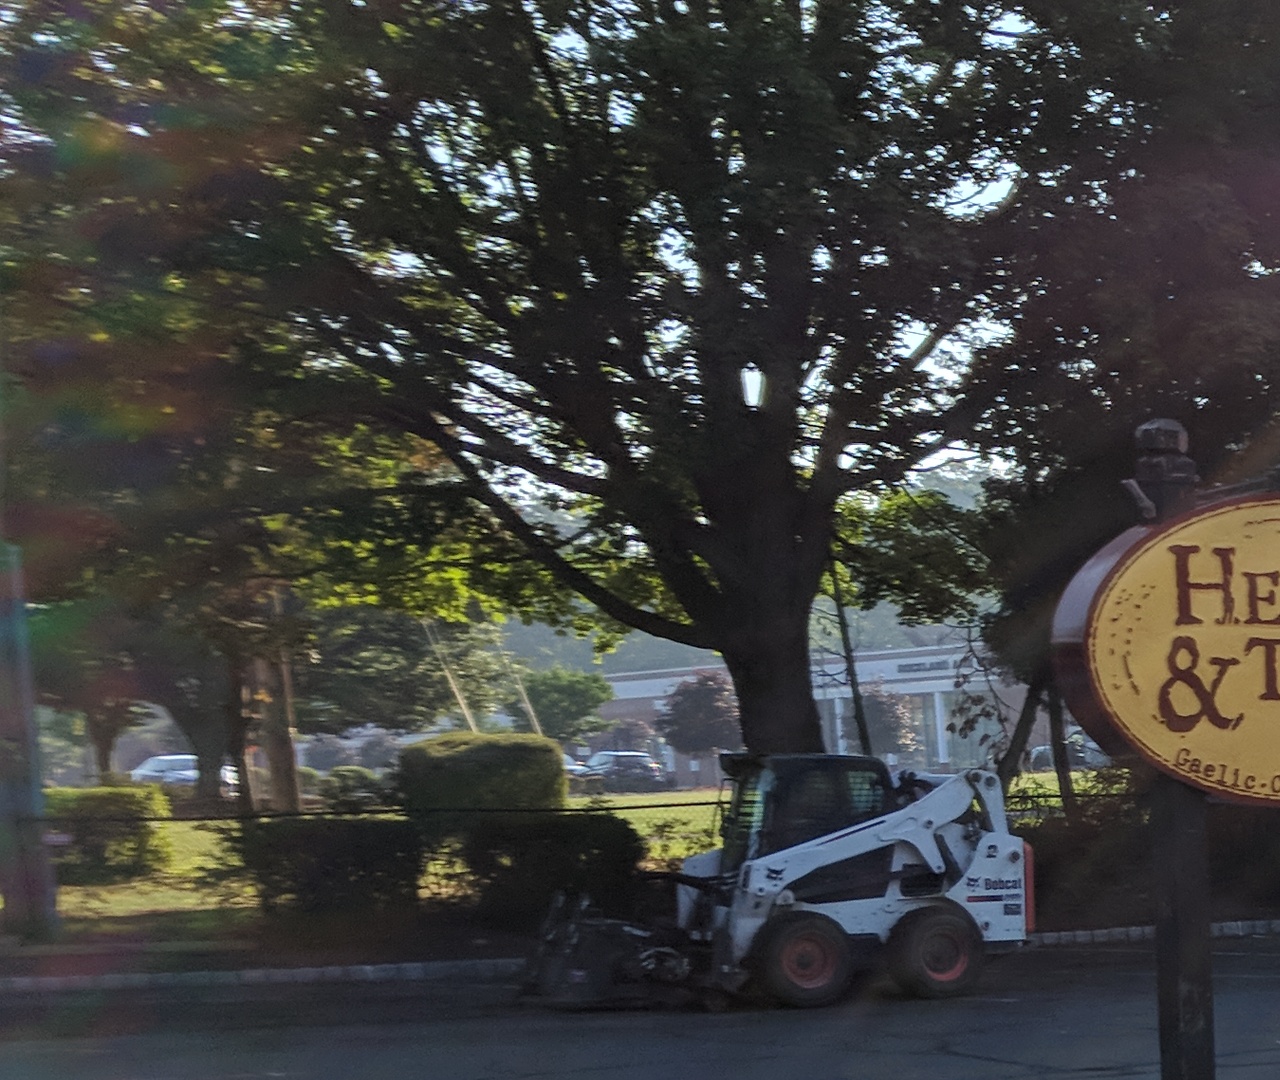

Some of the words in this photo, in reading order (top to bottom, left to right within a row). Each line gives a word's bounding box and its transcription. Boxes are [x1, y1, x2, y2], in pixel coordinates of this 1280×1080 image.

[1158, 635, 1243, 733] &
[1174, 747, 1259, 790] Gaelic
[984, 877, 1022, 891] Bobcat
